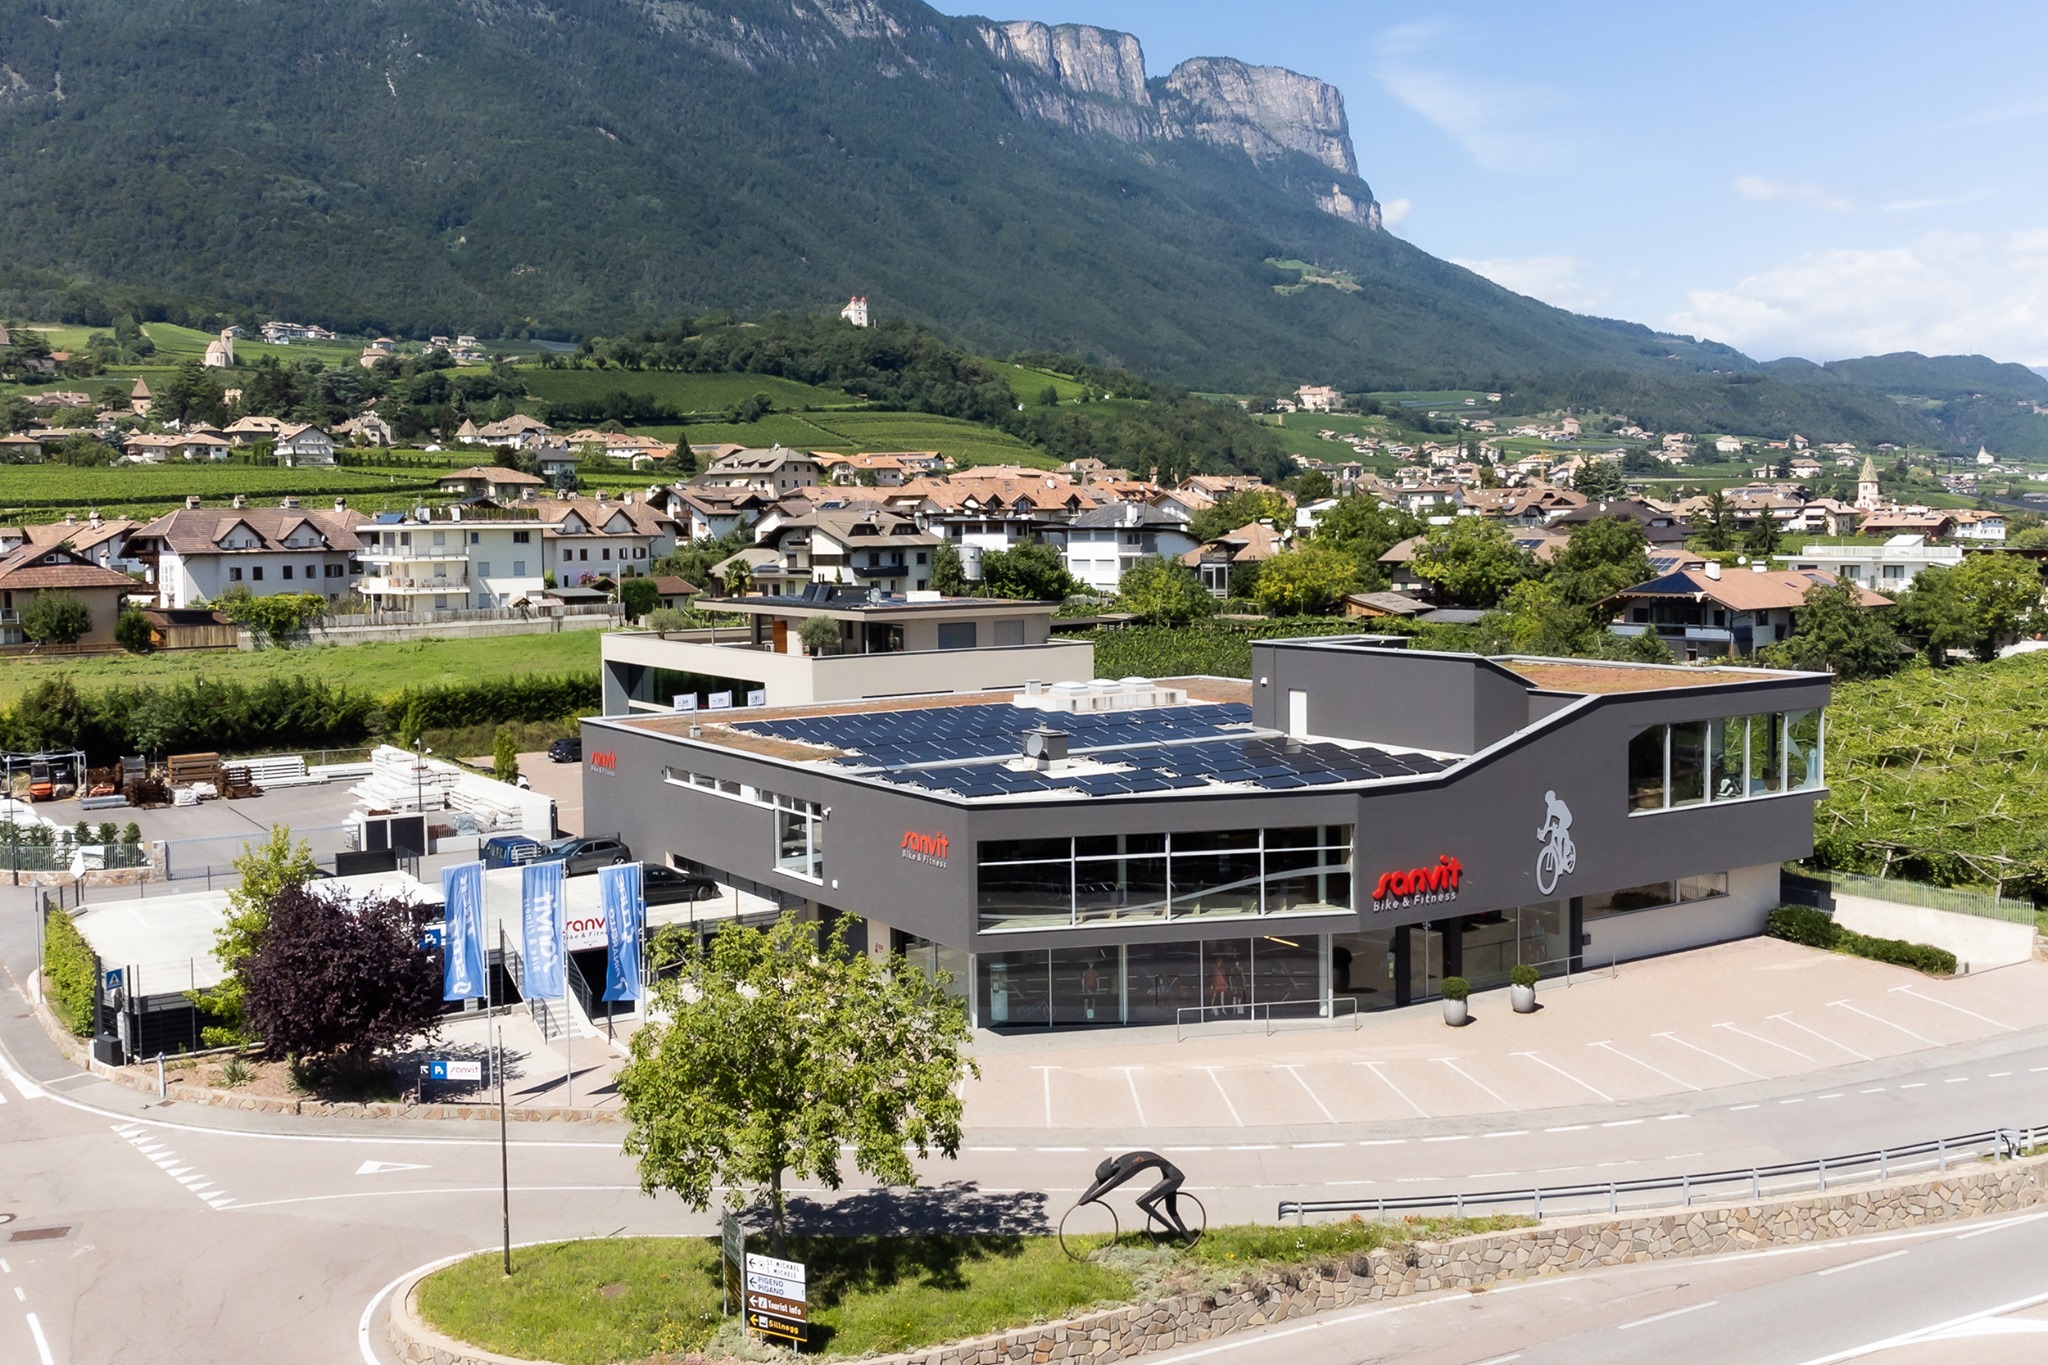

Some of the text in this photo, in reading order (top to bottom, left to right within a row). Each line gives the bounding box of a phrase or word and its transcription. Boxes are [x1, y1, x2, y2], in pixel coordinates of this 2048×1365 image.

[901, 831, 949, 859] sanvit
[902, 849, 915, 860] Bike
[922, 854, 947, 869] Fitness
[1372, 854, 1462, 899] sanvit
[1373, 892, 1457, 912] Bike & Fitness
[449, 1065, 479, 1074] sanvit
[776, 1261, 800, 1272] MICHAEL
[757, 1275, 784, 1288] PIGENO
[757, 1284, 785, 1296] PIGANO
[768, 1300, 802, 1316] Tourist info
